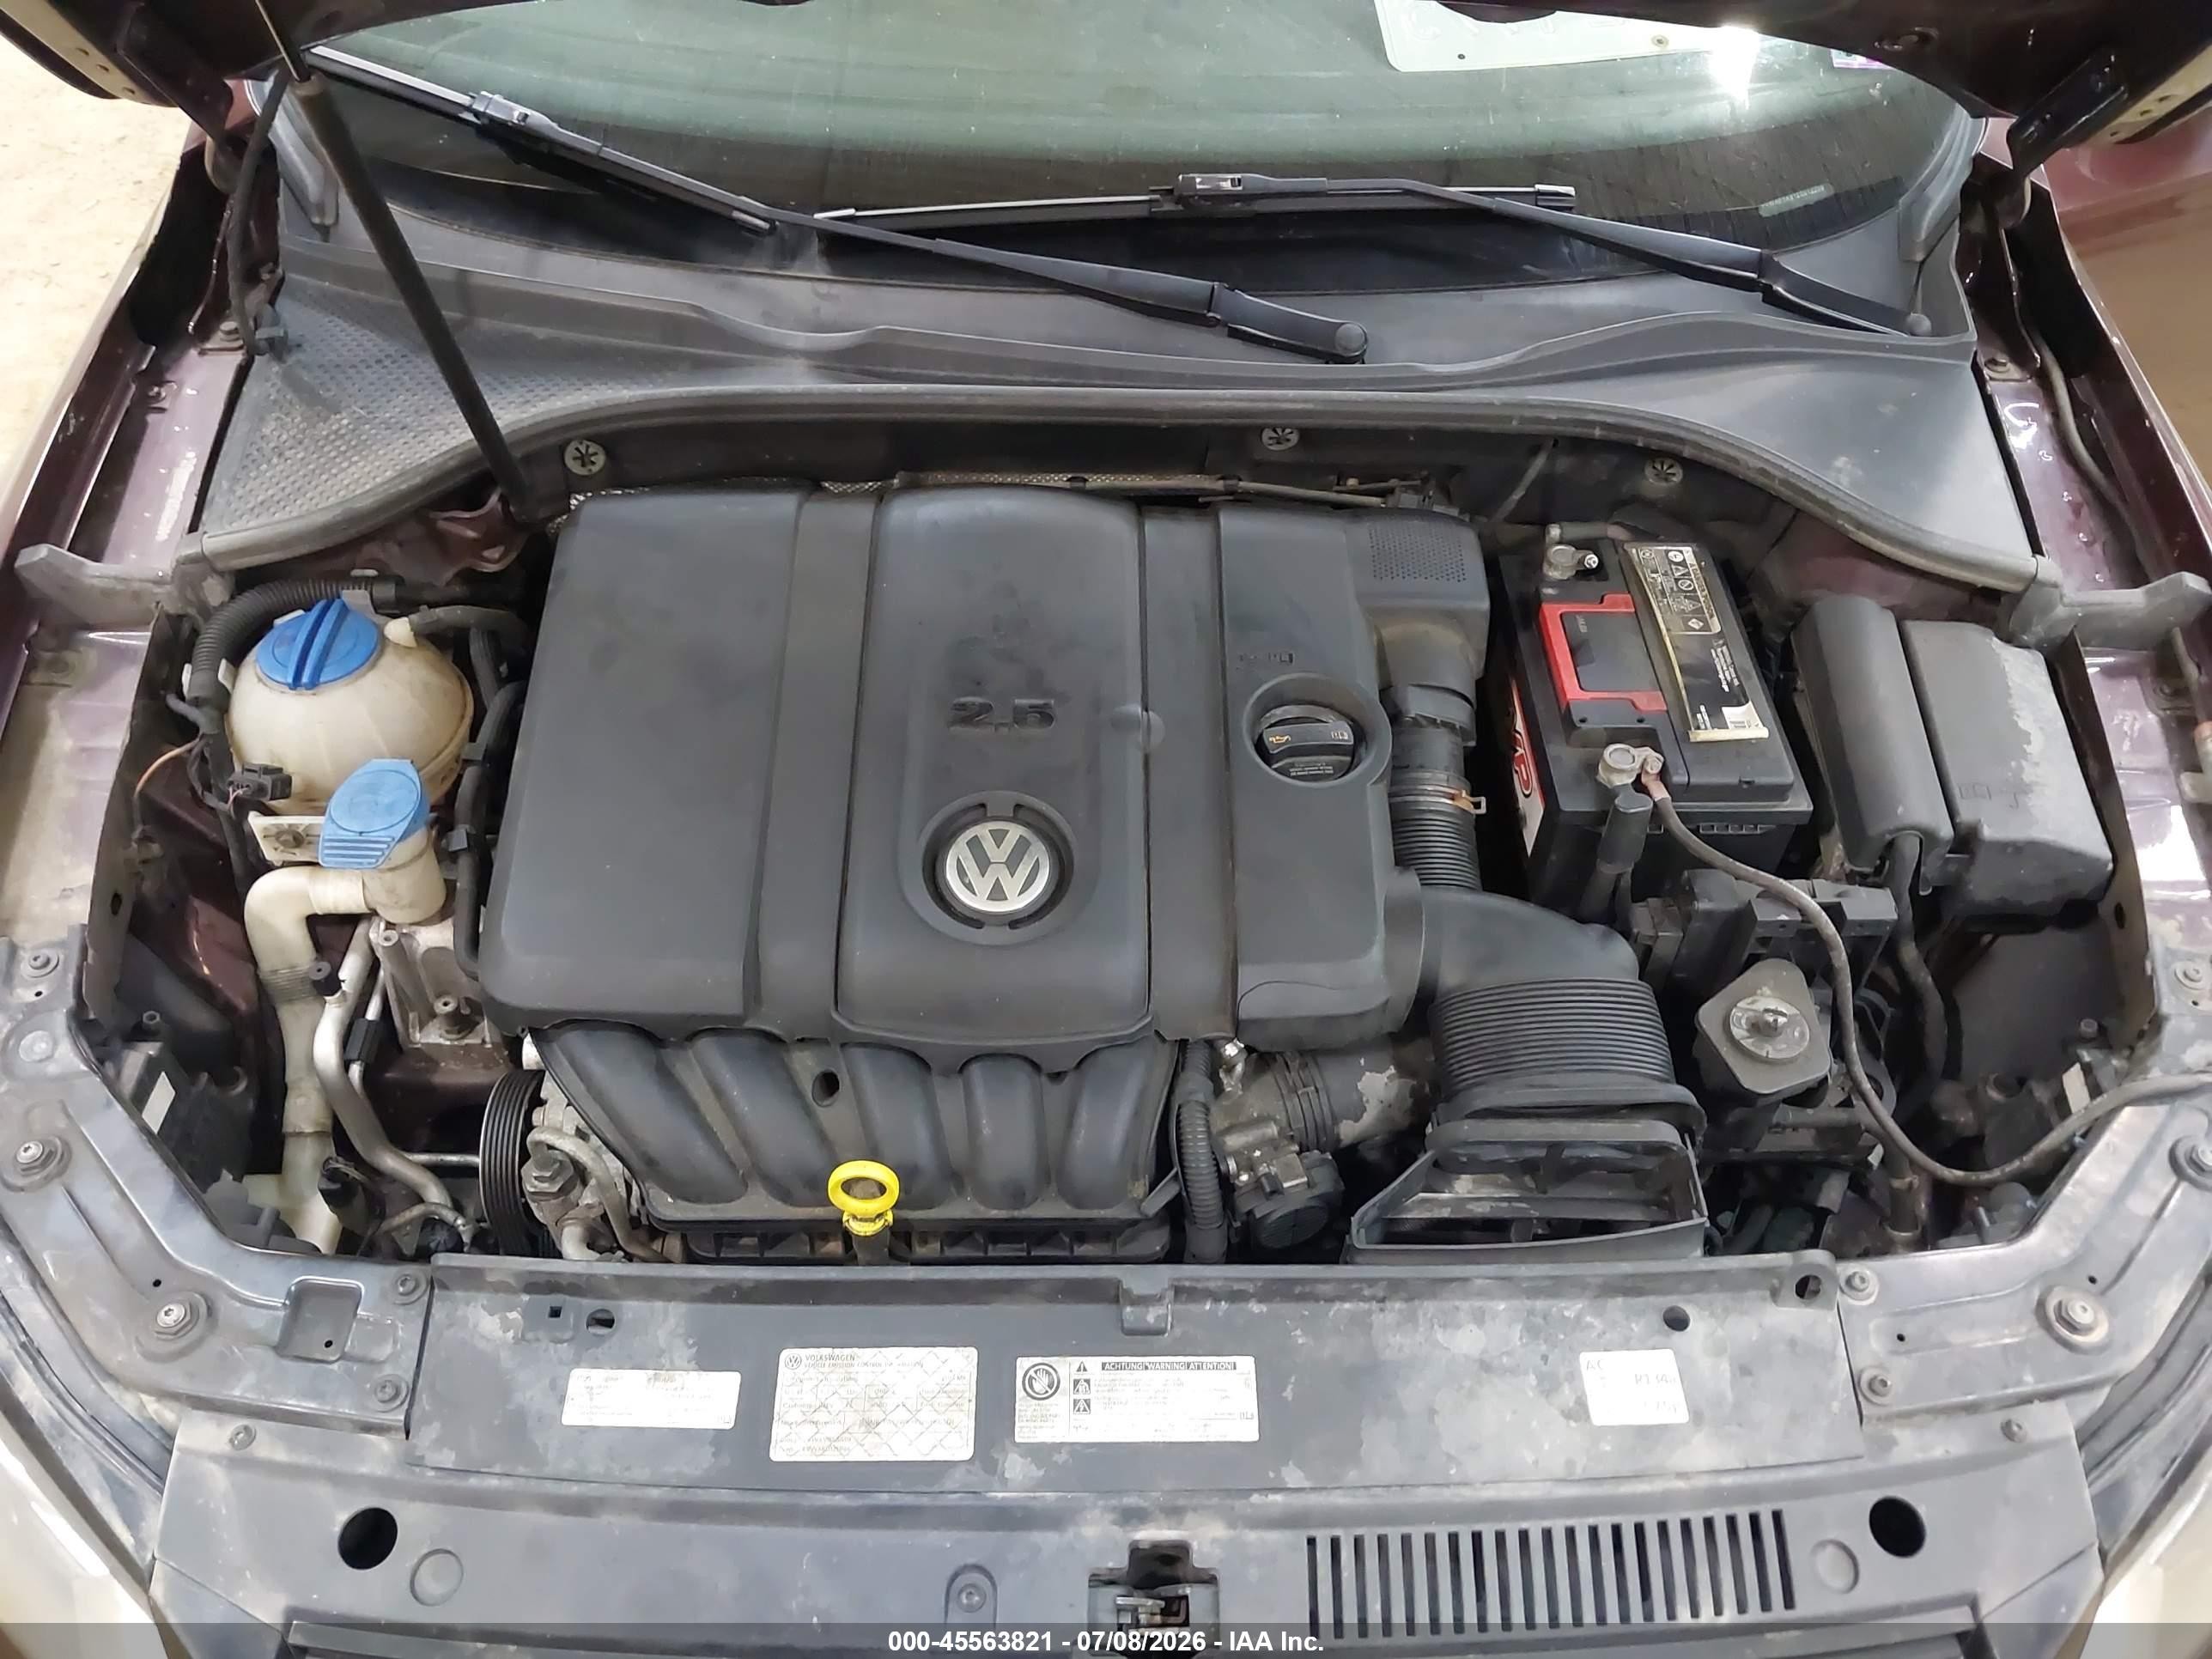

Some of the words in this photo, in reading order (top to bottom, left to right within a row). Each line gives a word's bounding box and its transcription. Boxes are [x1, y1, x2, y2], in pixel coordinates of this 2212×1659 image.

[947, 696, 1057, 732] 2.5
[951, 824, 1045, 907] VW
[1104, 1362, 1145, 1370] ACHTUNG!
[1146, 1362, 1187, 1370] WARNING!
